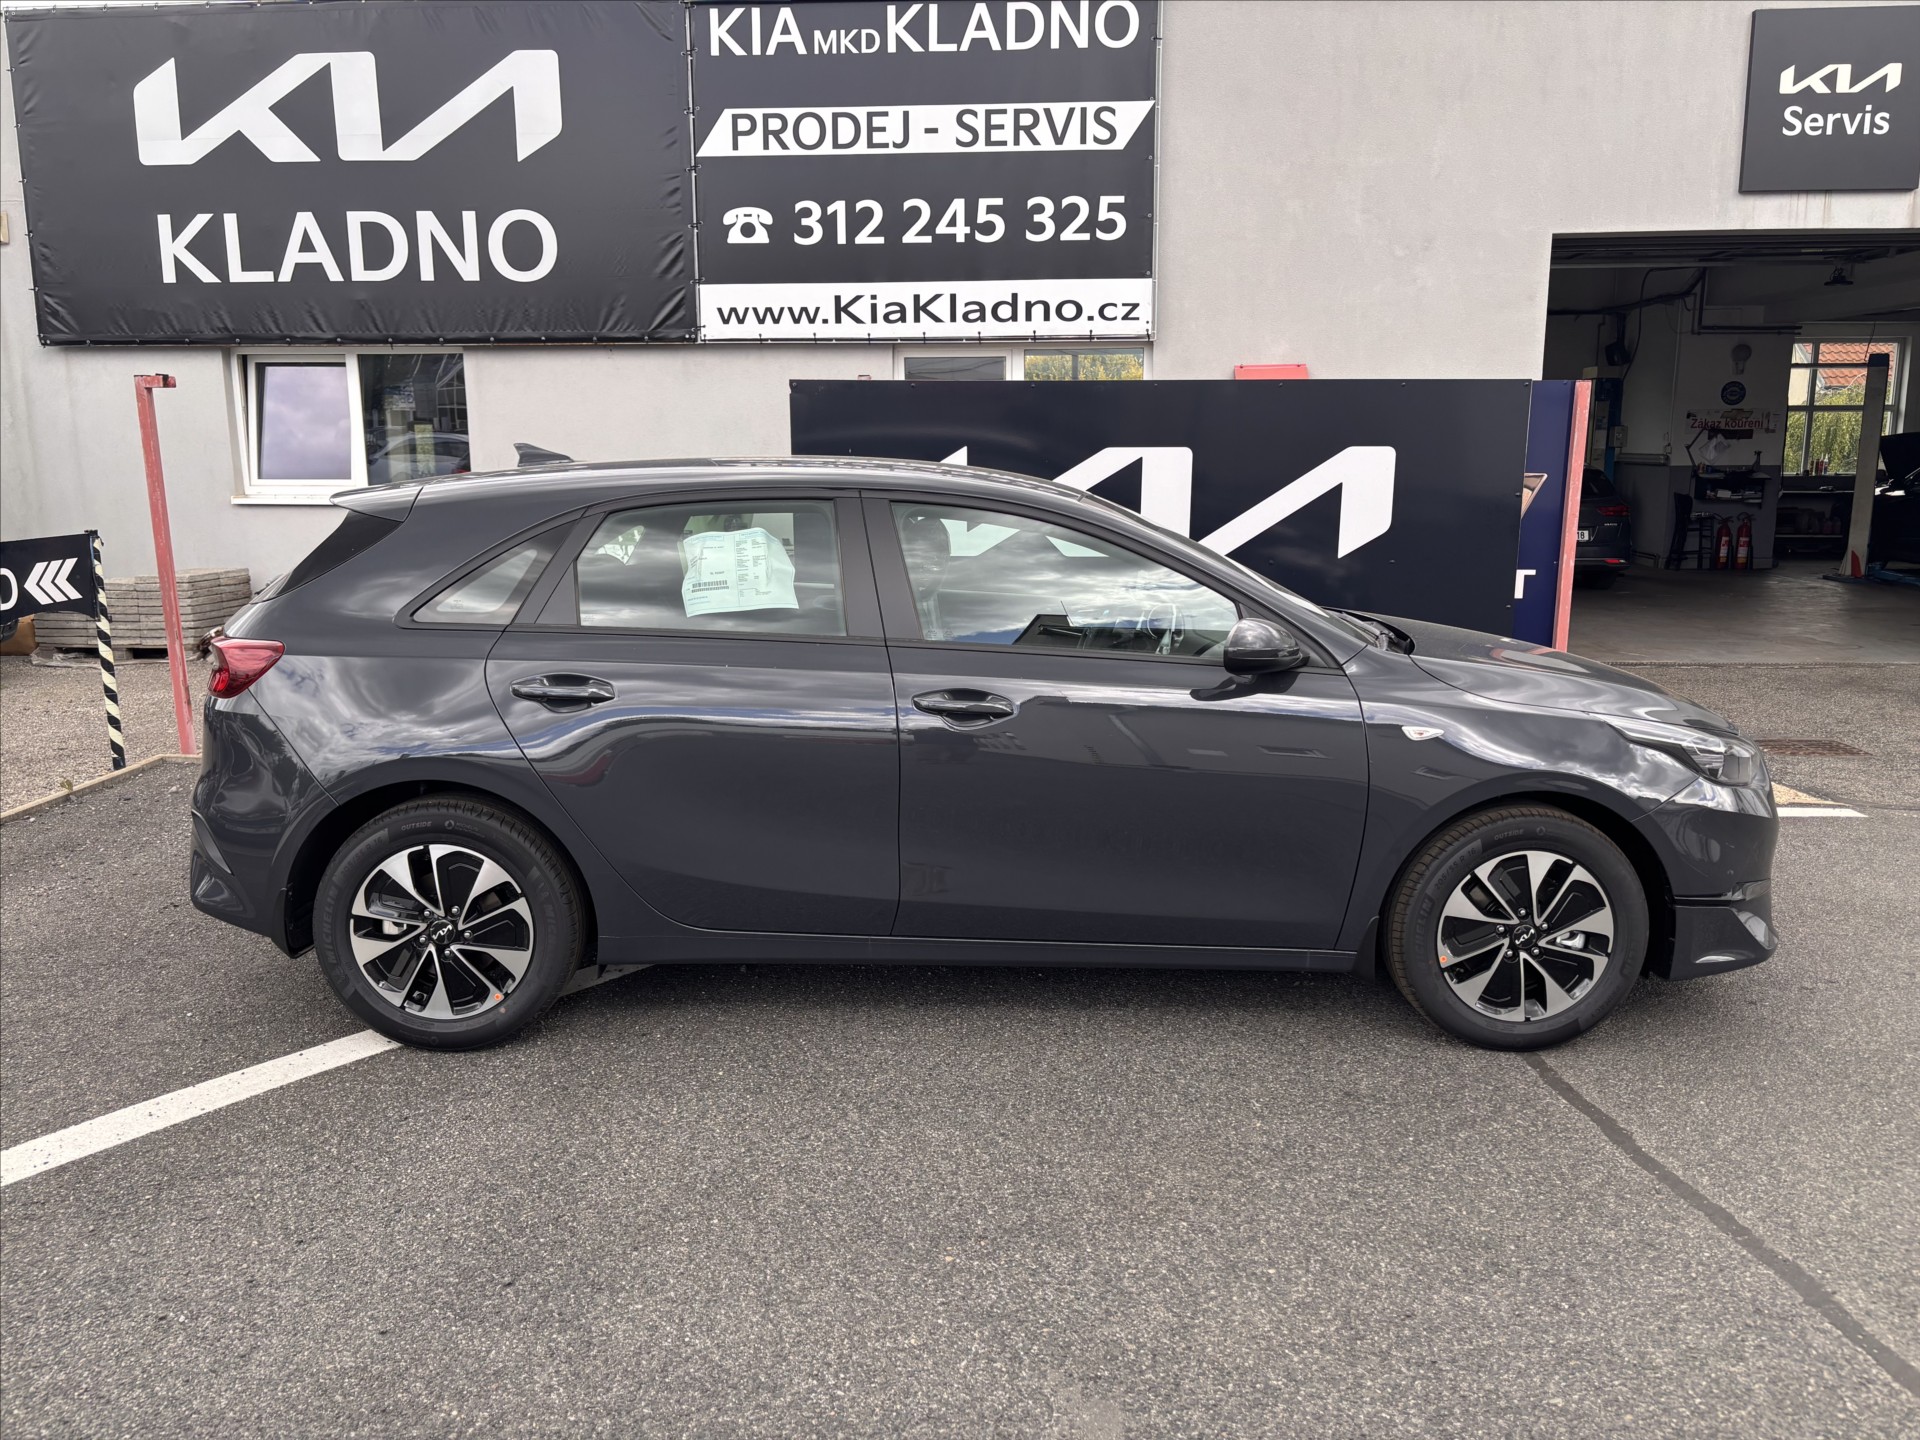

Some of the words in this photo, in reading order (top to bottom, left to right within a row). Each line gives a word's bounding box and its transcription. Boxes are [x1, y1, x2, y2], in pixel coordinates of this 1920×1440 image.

[709, 6, 807, 57] KIA
[813, 29, 881, 55] MKD
[886, 0, 1140, 53] KLADNO
[1779, 62, 1903, 95] KIA
[133, 49, 562, 166] KIA
[731, 110, 911, 151] PRODEJ
[955, 105, 1118, 148] SERVIS
[1782, 104, 1890, 136] Servis
[793, 199, 885, 246] 312
[901, 196, 1006, 243] 245
[1025, 195, 1127, 242] 325
[157, 208, 559, 284] KLADNO
[716, 293, 1141, 325] www.KiaKladno.cz
[401, 821, 433, 831] OUTSIDE
